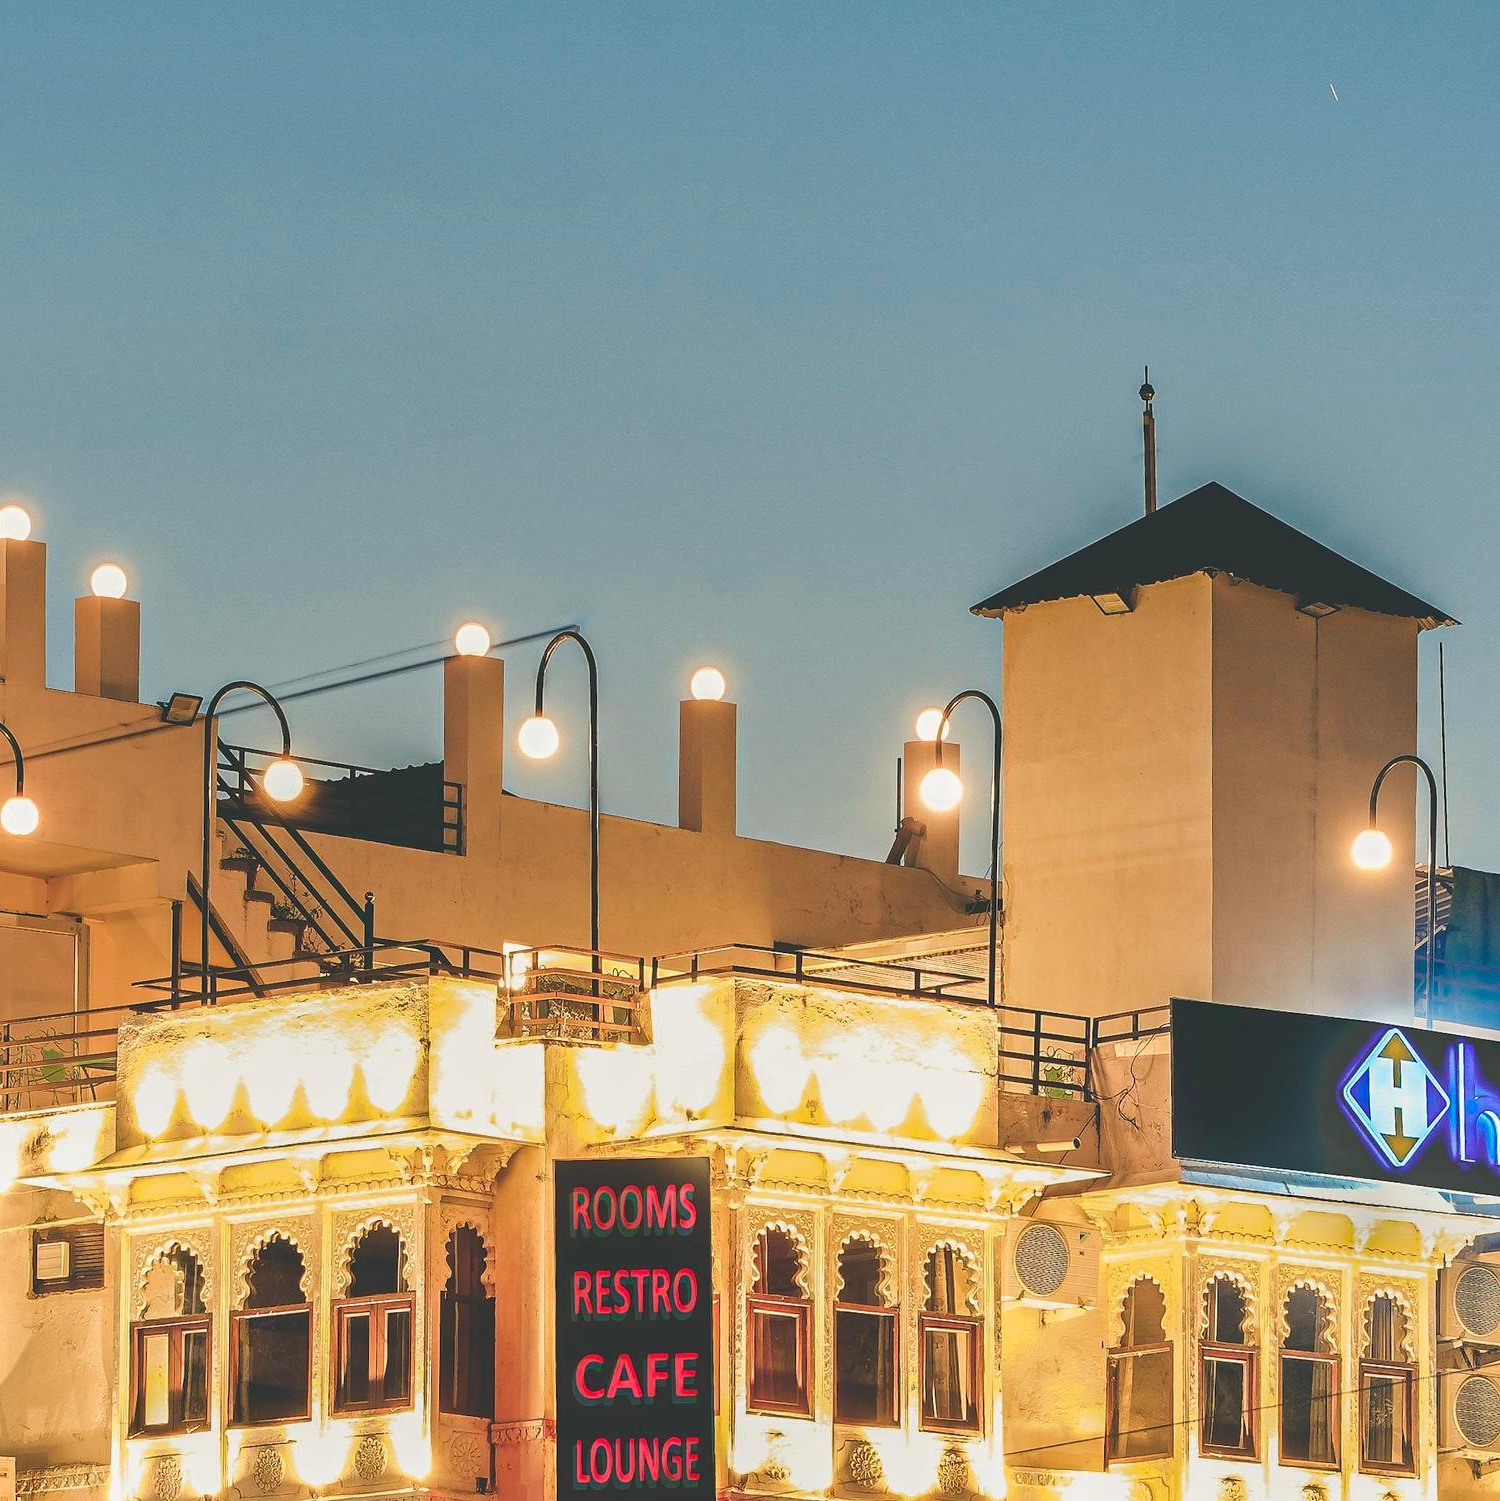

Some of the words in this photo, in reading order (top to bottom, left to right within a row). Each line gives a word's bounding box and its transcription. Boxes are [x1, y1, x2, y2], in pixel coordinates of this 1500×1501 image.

[572, 1183, 697, 1231] ROOMS
[573, 1267, 698, 1315] RESTRO
[574, 1352, 699, 1400] CAFE
[575, 1436, 700, 1484] LOUNGE
